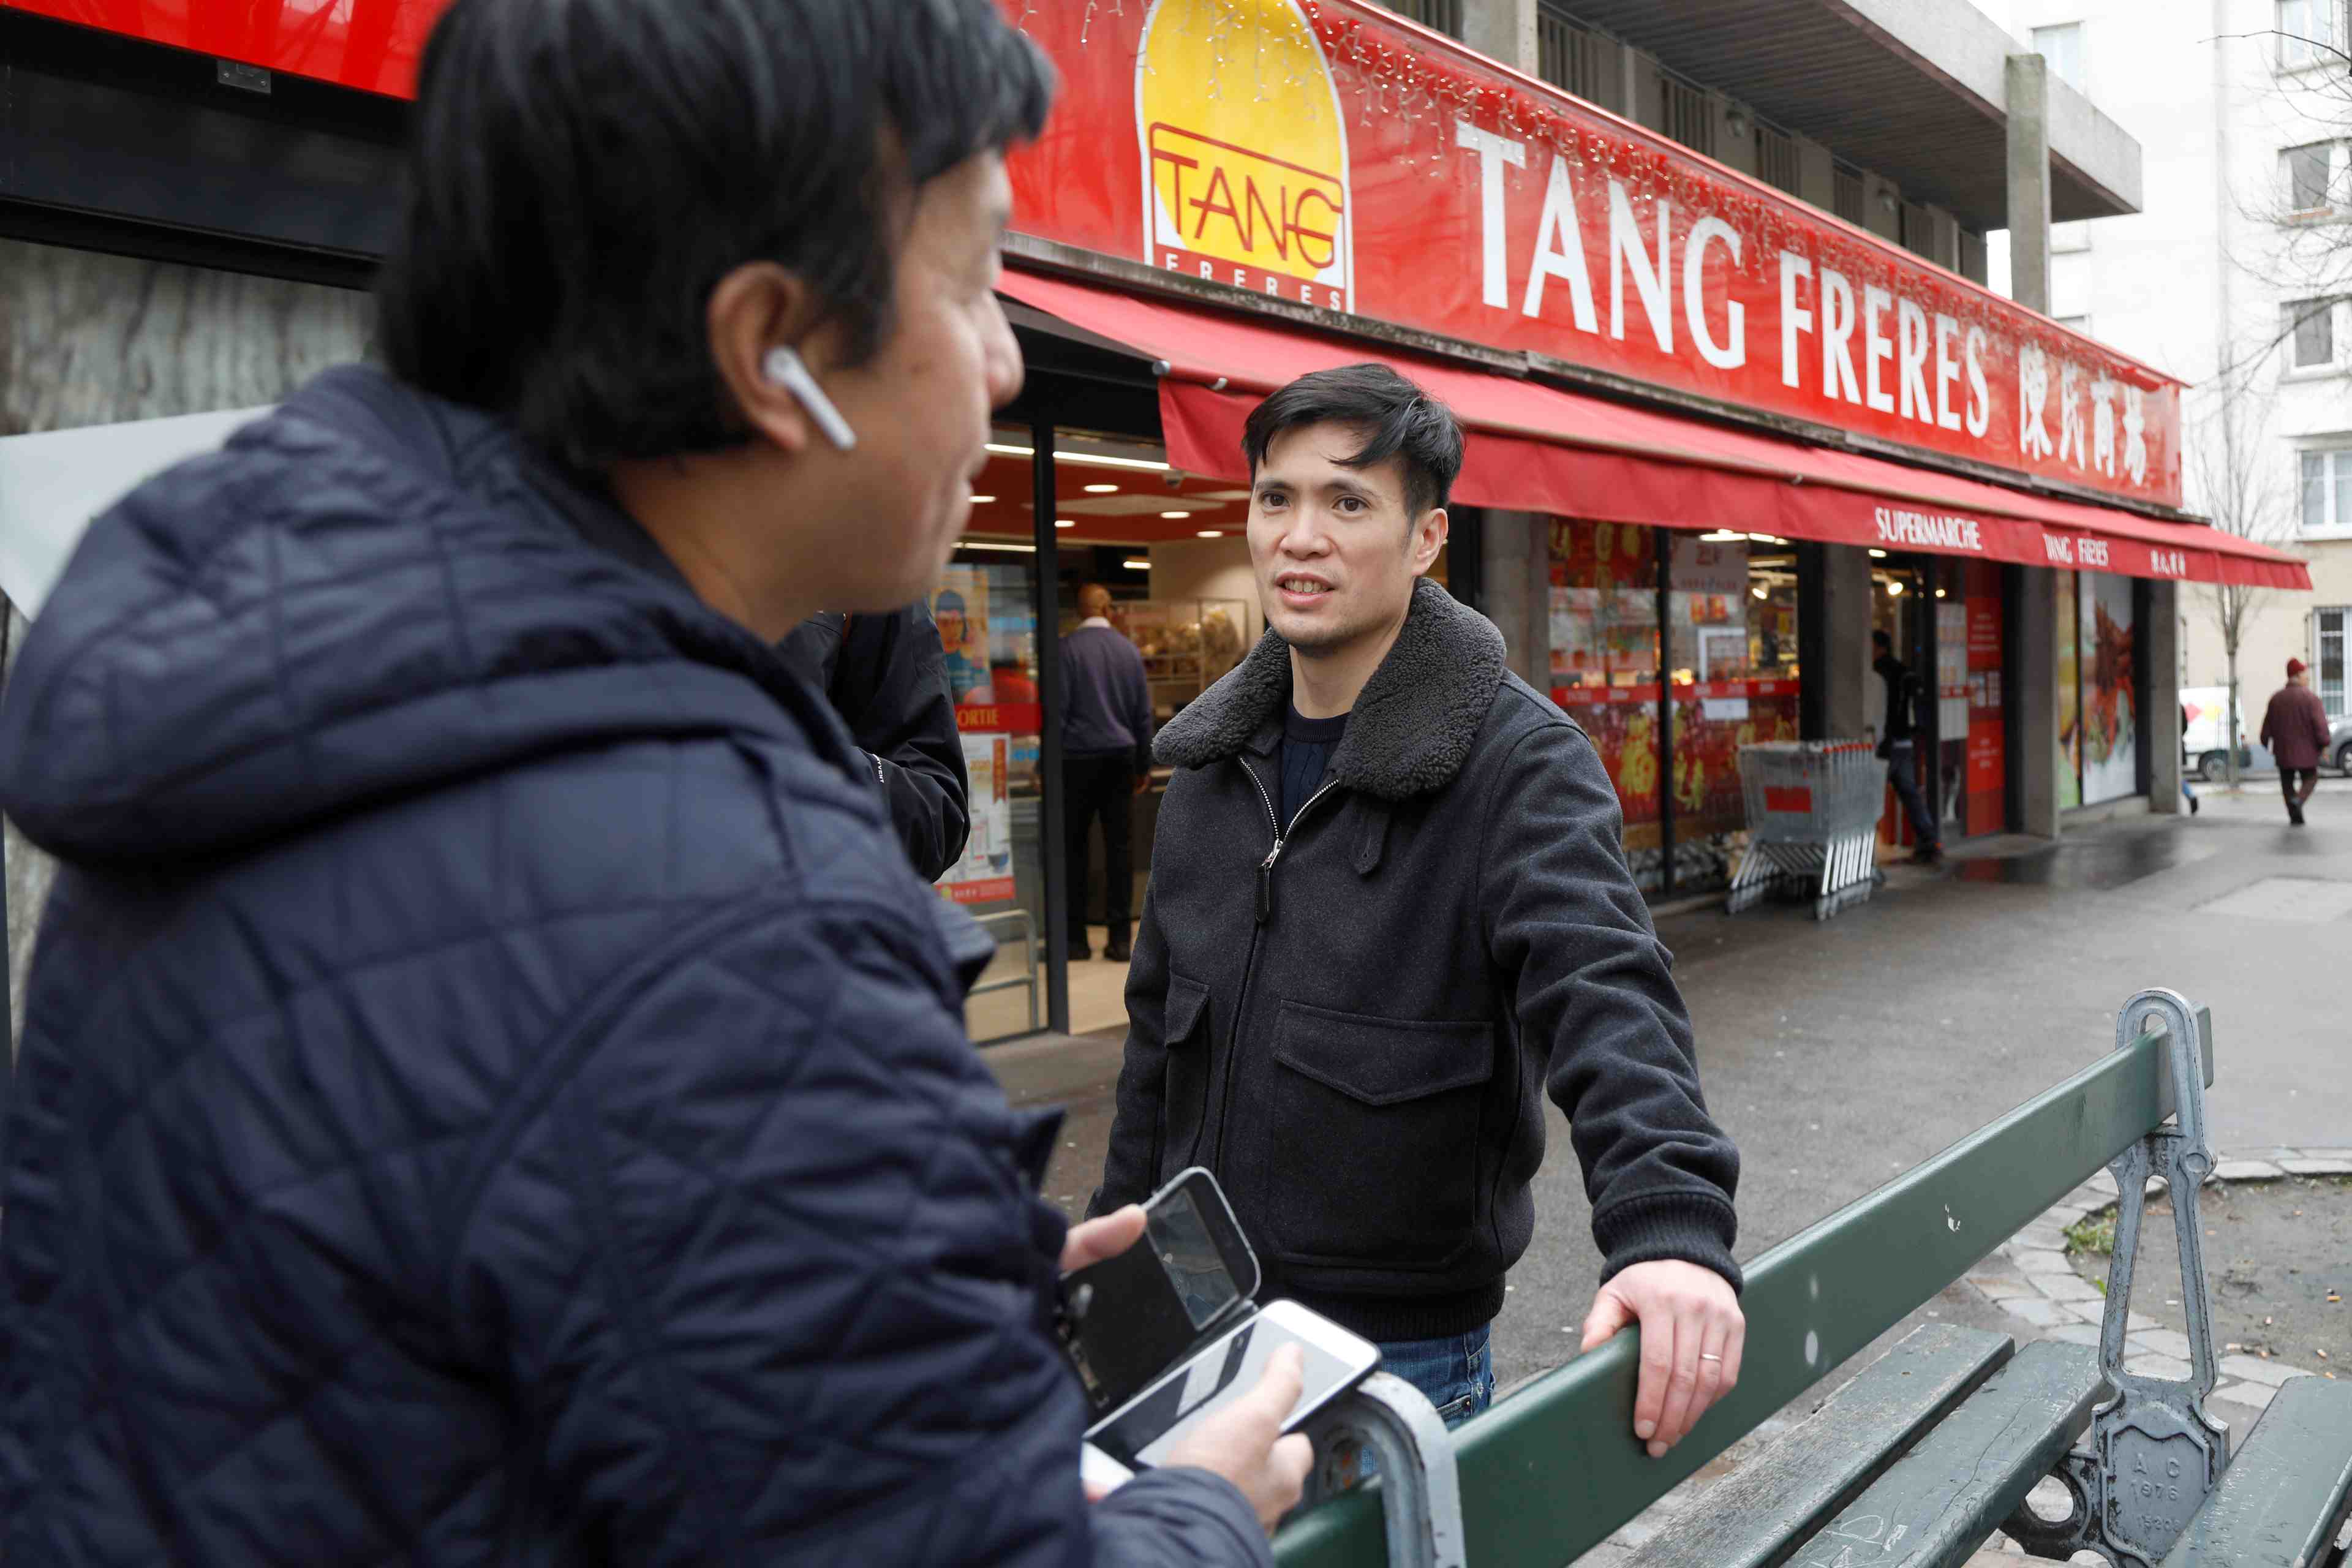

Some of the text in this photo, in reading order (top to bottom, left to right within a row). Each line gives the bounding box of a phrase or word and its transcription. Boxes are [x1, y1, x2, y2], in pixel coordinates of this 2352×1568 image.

[1153, 147, 1342, 269] TANG
[1166, 252, 1341, 312] FRERES
[1456, 120, 1989, 438] TANG FRERES
[957, 709, 1000, 726] ORTIE
[872, 753, 884, 783] YVENT
[2133, 1452, 2147, 1475] A
